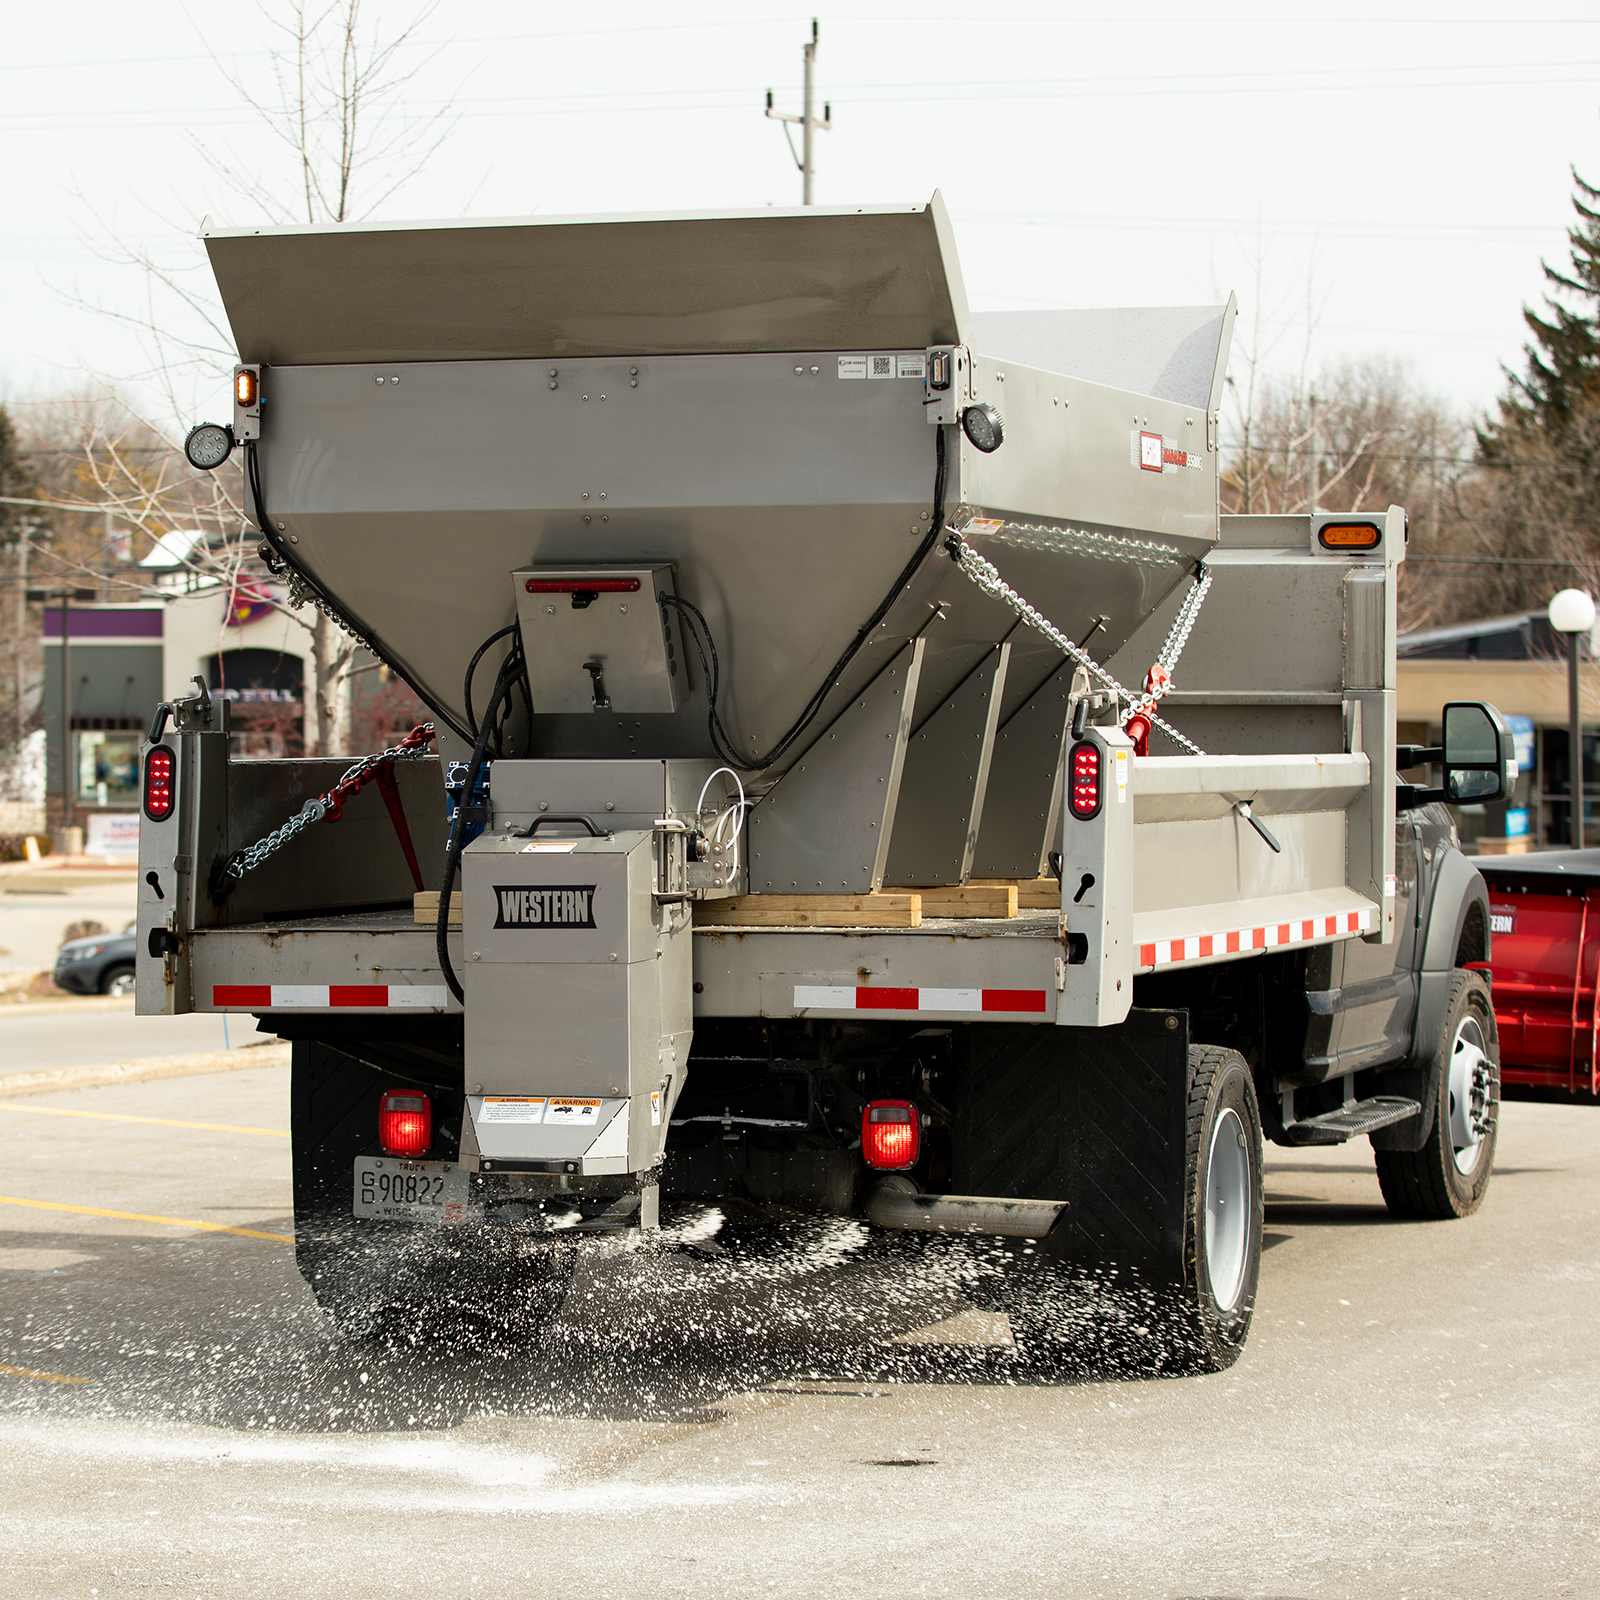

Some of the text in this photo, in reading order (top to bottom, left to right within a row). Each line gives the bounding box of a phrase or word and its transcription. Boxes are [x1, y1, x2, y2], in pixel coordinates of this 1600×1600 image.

[500, 890, 588, 923] WESTERN
[399, 1163, 426, 1171] TRUCK
[379, 1173, 445, 1206] 90822
[383, 1206, 437, 1218] WISCONN
